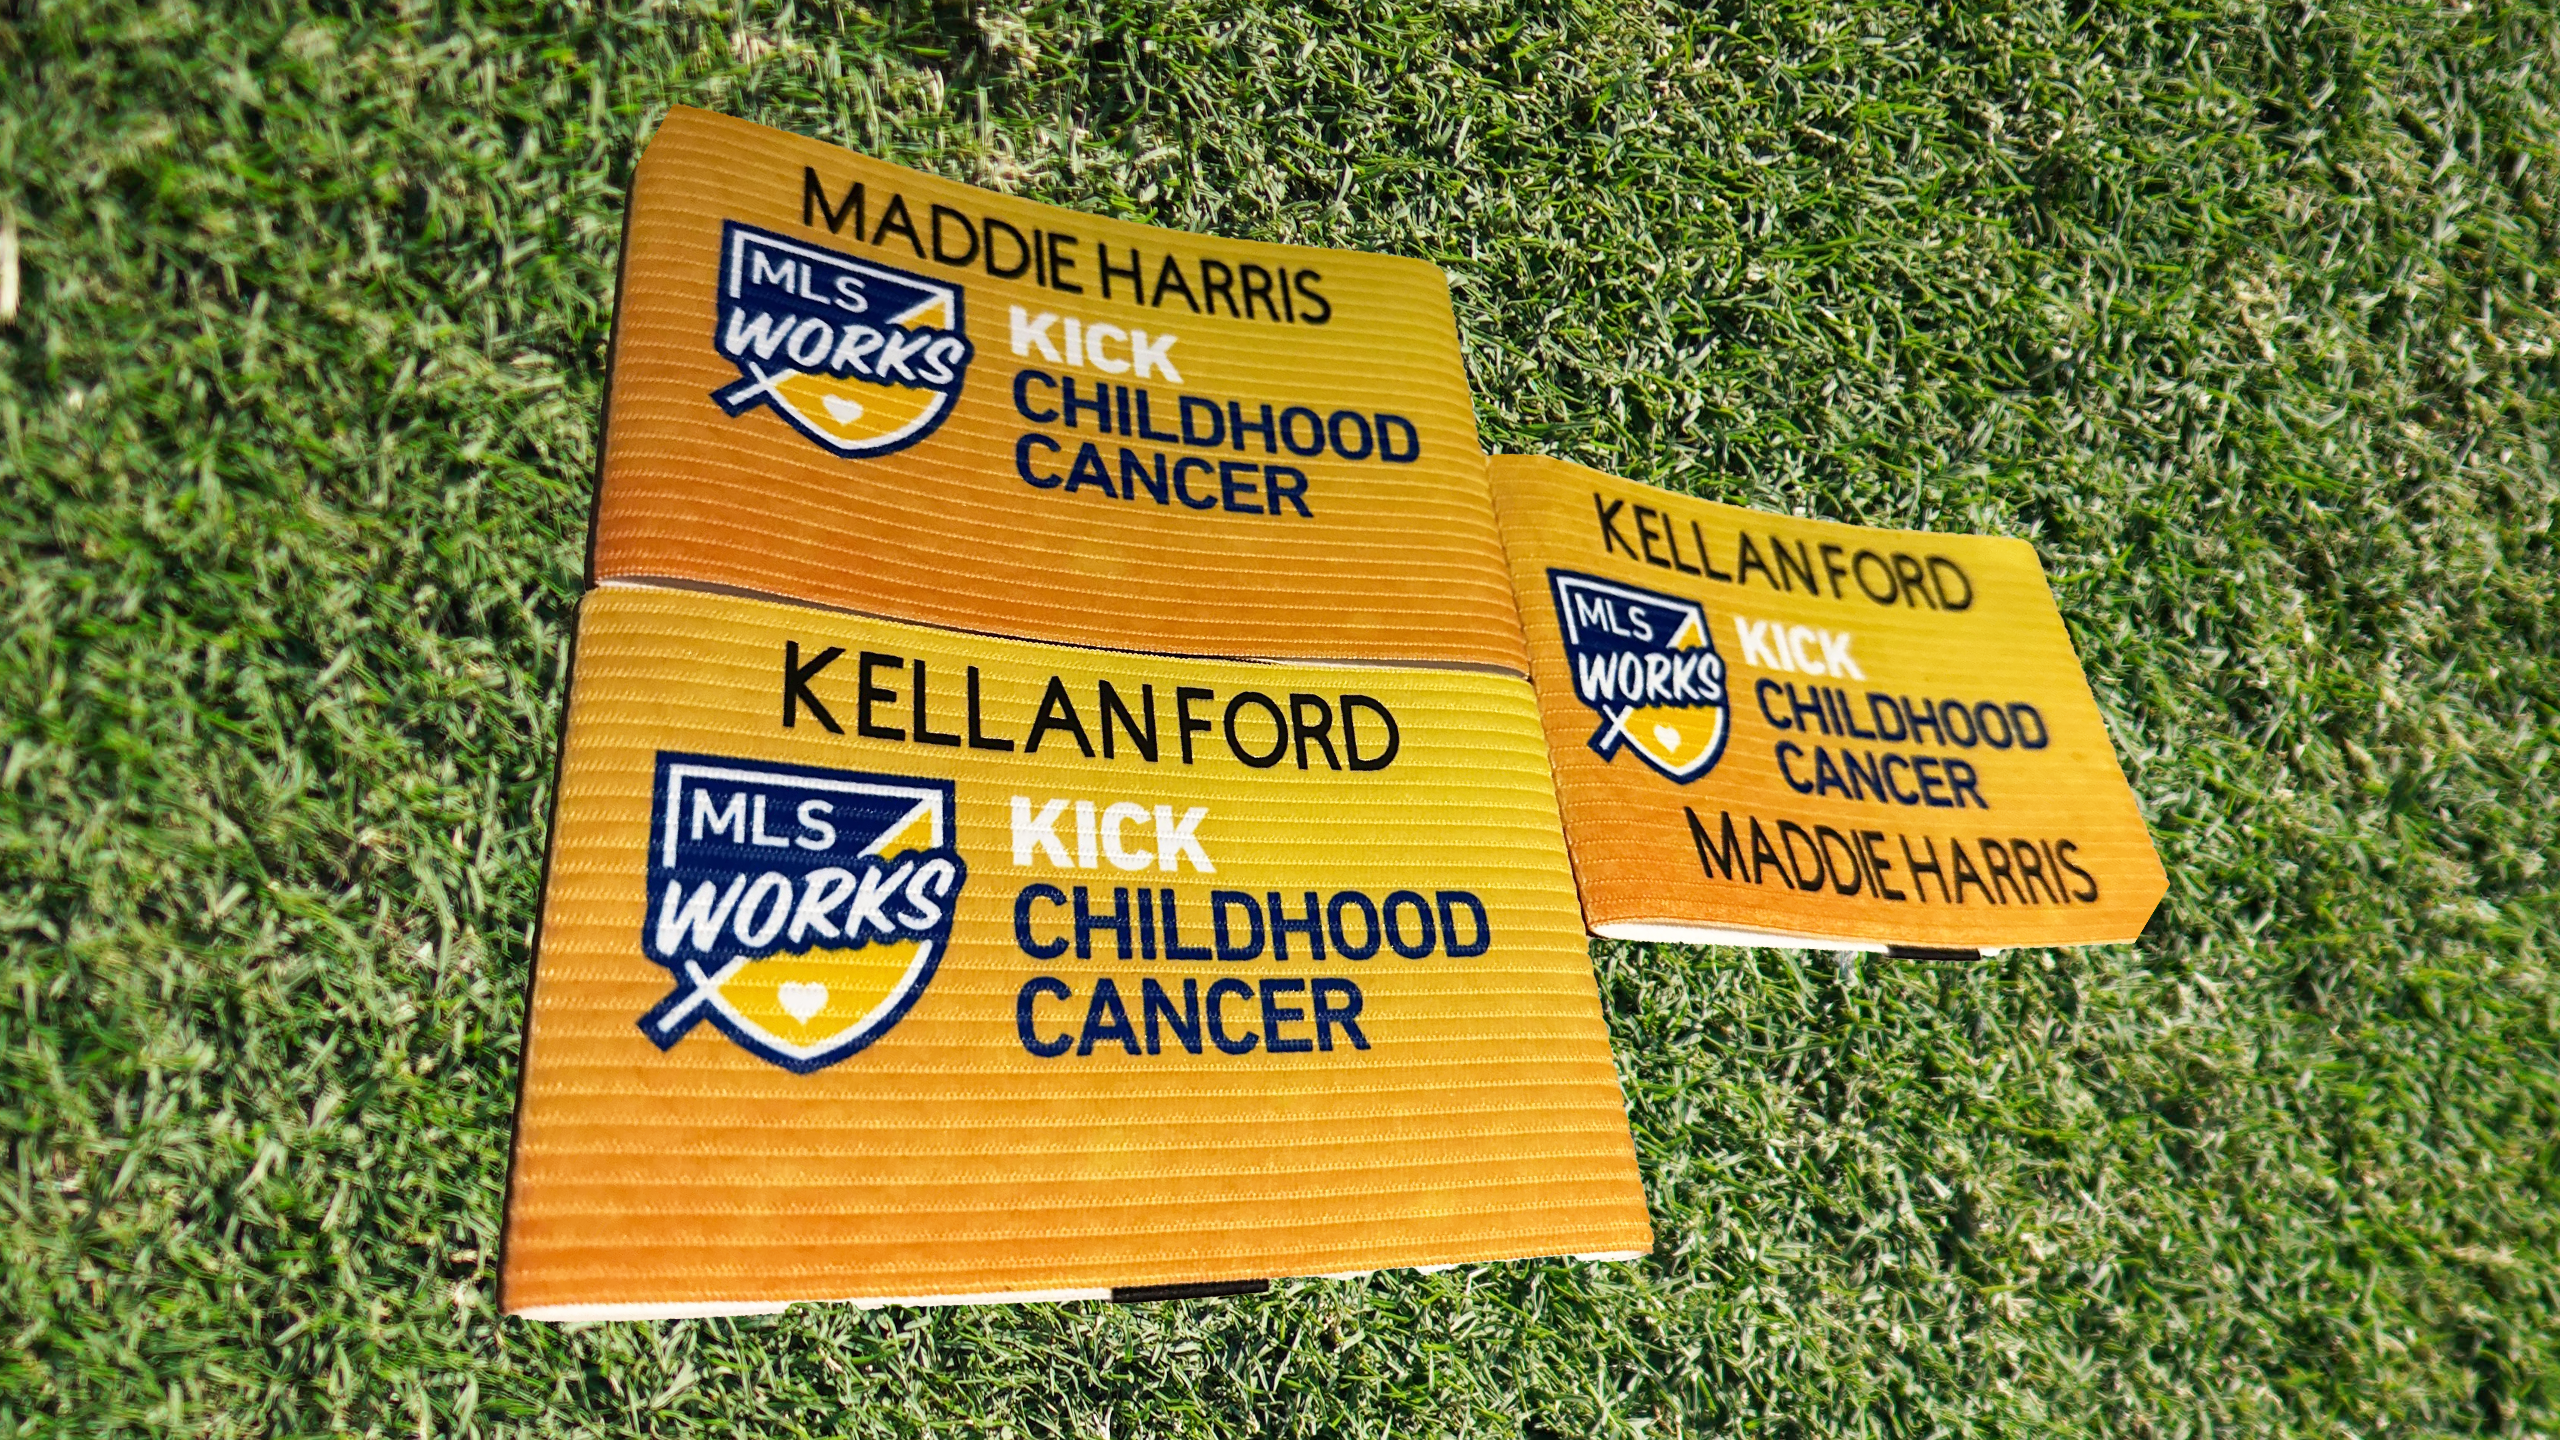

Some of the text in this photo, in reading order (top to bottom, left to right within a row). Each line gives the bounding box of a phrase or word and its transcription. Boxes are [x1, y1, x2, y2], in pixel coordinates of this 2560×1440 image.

[752, 252, 869, 314] MLS
[802, 167, 1333, 326] MADDIE HARRIS
[721, 308, 966, 386] WORKS
[1010, 306, 1183, 384] KICK
[1013, 370, 1420, 464] CHILDHOOD
[1015, 433, 1314, 518] CANCER
[1594, 492, 1973, 612] KELLAN FORD
[1576, 596, 1653, 643] MLS
[1734, 616, 1866, 680] KICK
[782, 641, 1401, 772] KELLAN FORD
[1577, 651, 1724, 703] WORKS
[1754, 678, 2049, 750] CHILDHOOD
[1775, 740, 1989, 810] CANCER
[691, 788, 835, 852] MLS
[1010, 795, 1217, 874] KICK
[1684, 806, 2098, 904] MADDIE HARRIS
[656, 858, 957, 958] WORKS
[1014, 883, 1492, 962] CHILDHOOD
[1016, 976, 1371, 1057] CANCER
